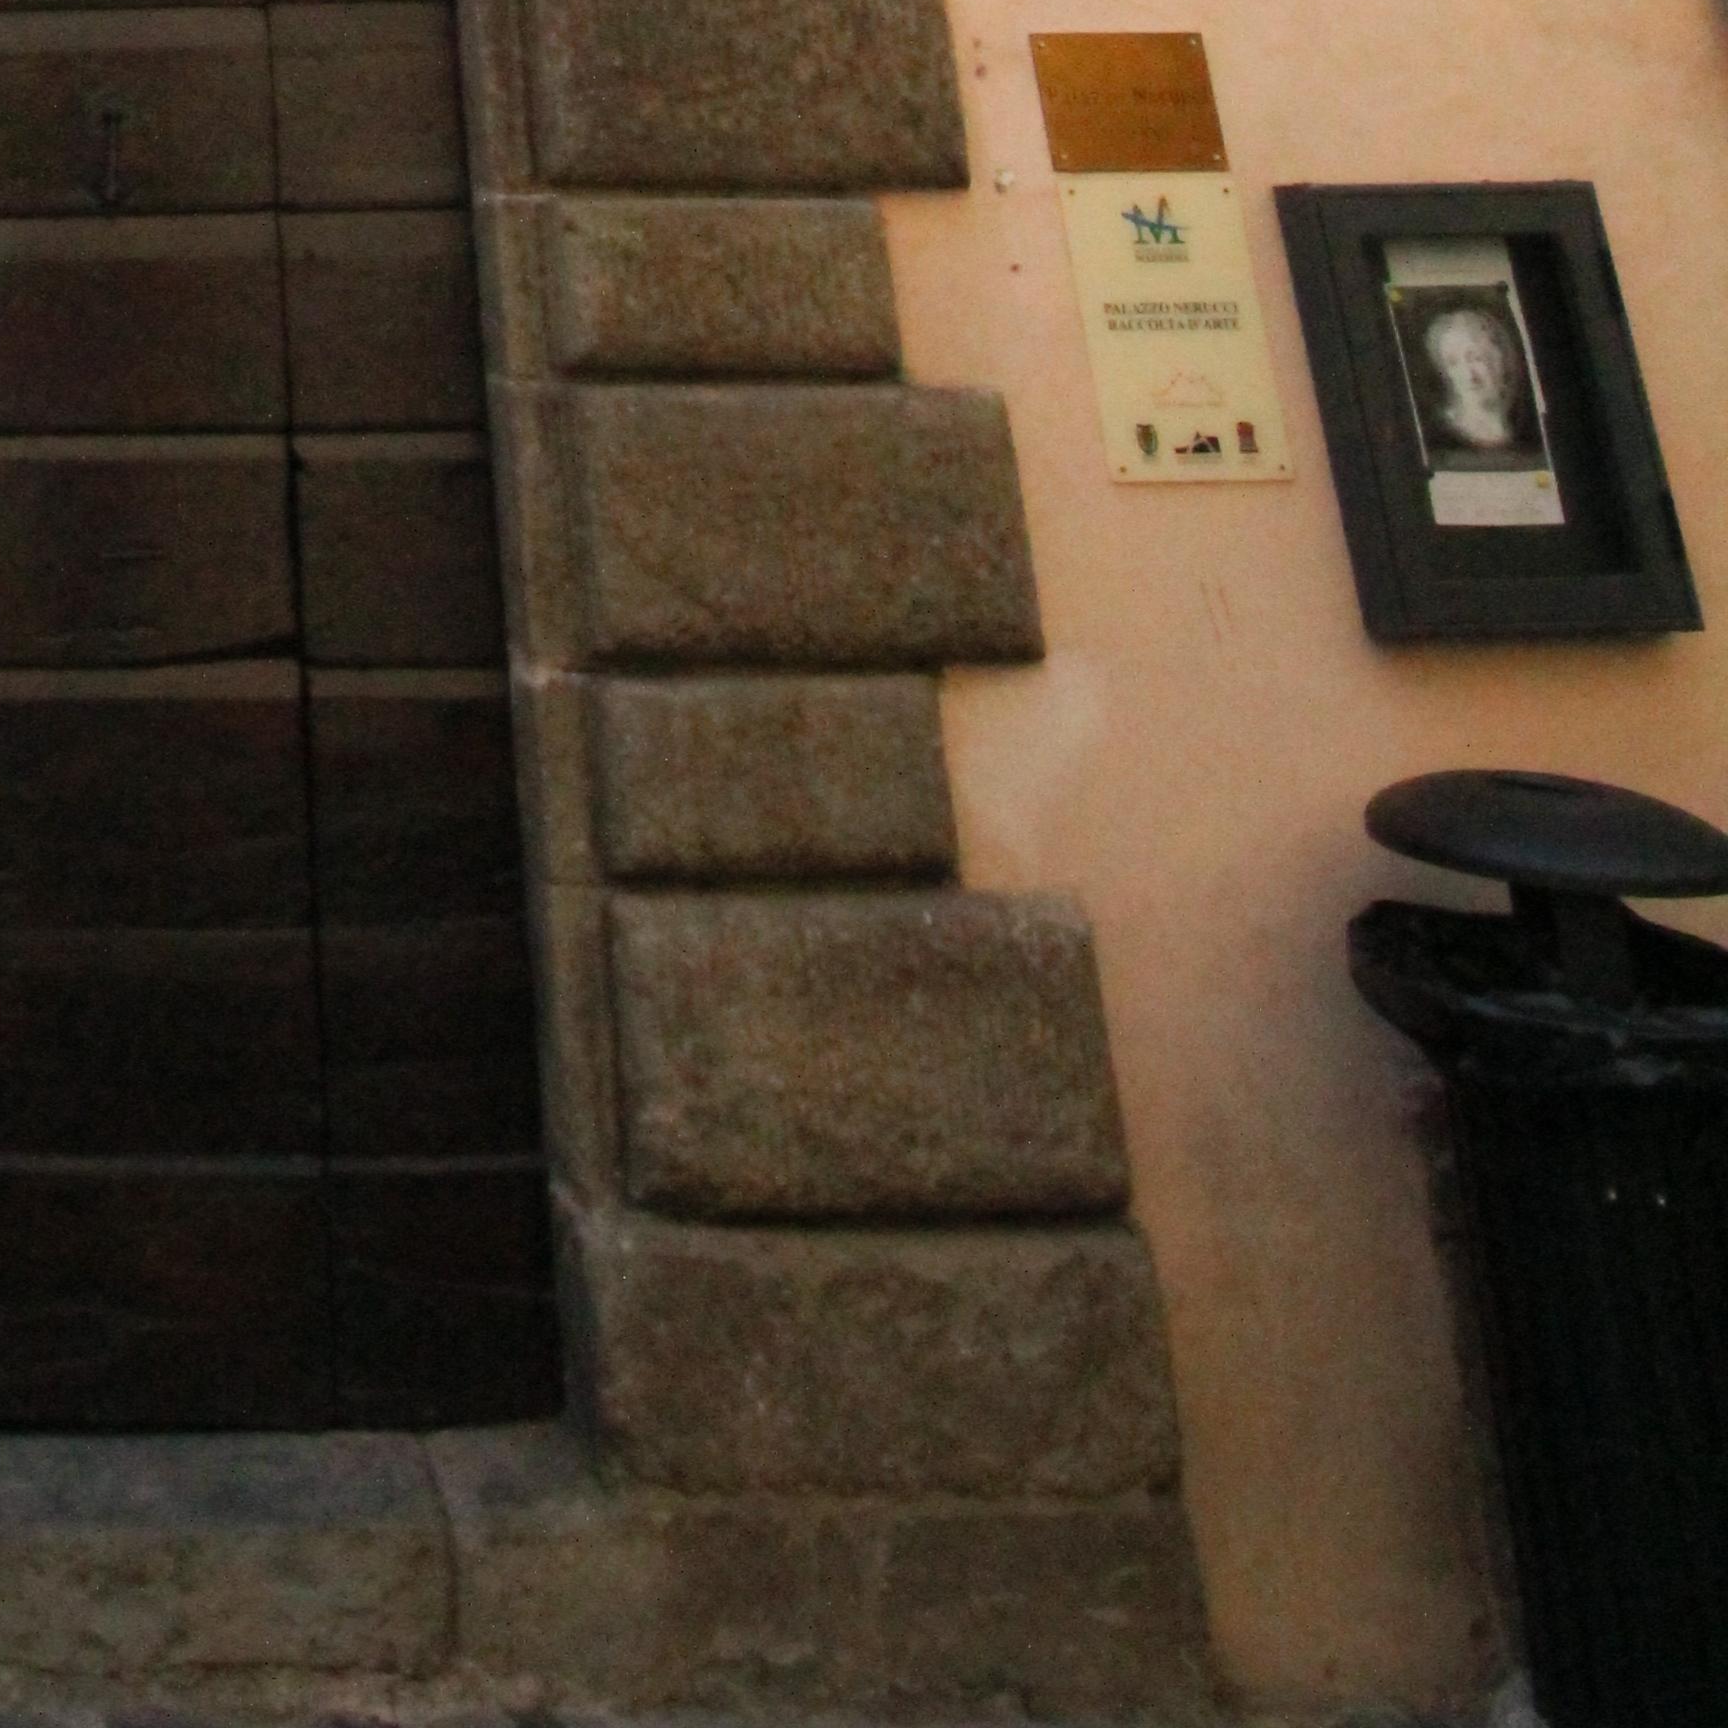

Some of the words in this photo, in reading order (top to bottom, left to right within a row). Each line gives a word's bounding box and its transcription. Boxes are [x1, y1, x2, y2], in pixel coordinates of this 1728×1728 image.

[1103, 302, 1170, 315] PALAZZO
[1172, 302, 1239, 315] NERUCCI
[1108, 317, 1185, 331] RACCOLTA
